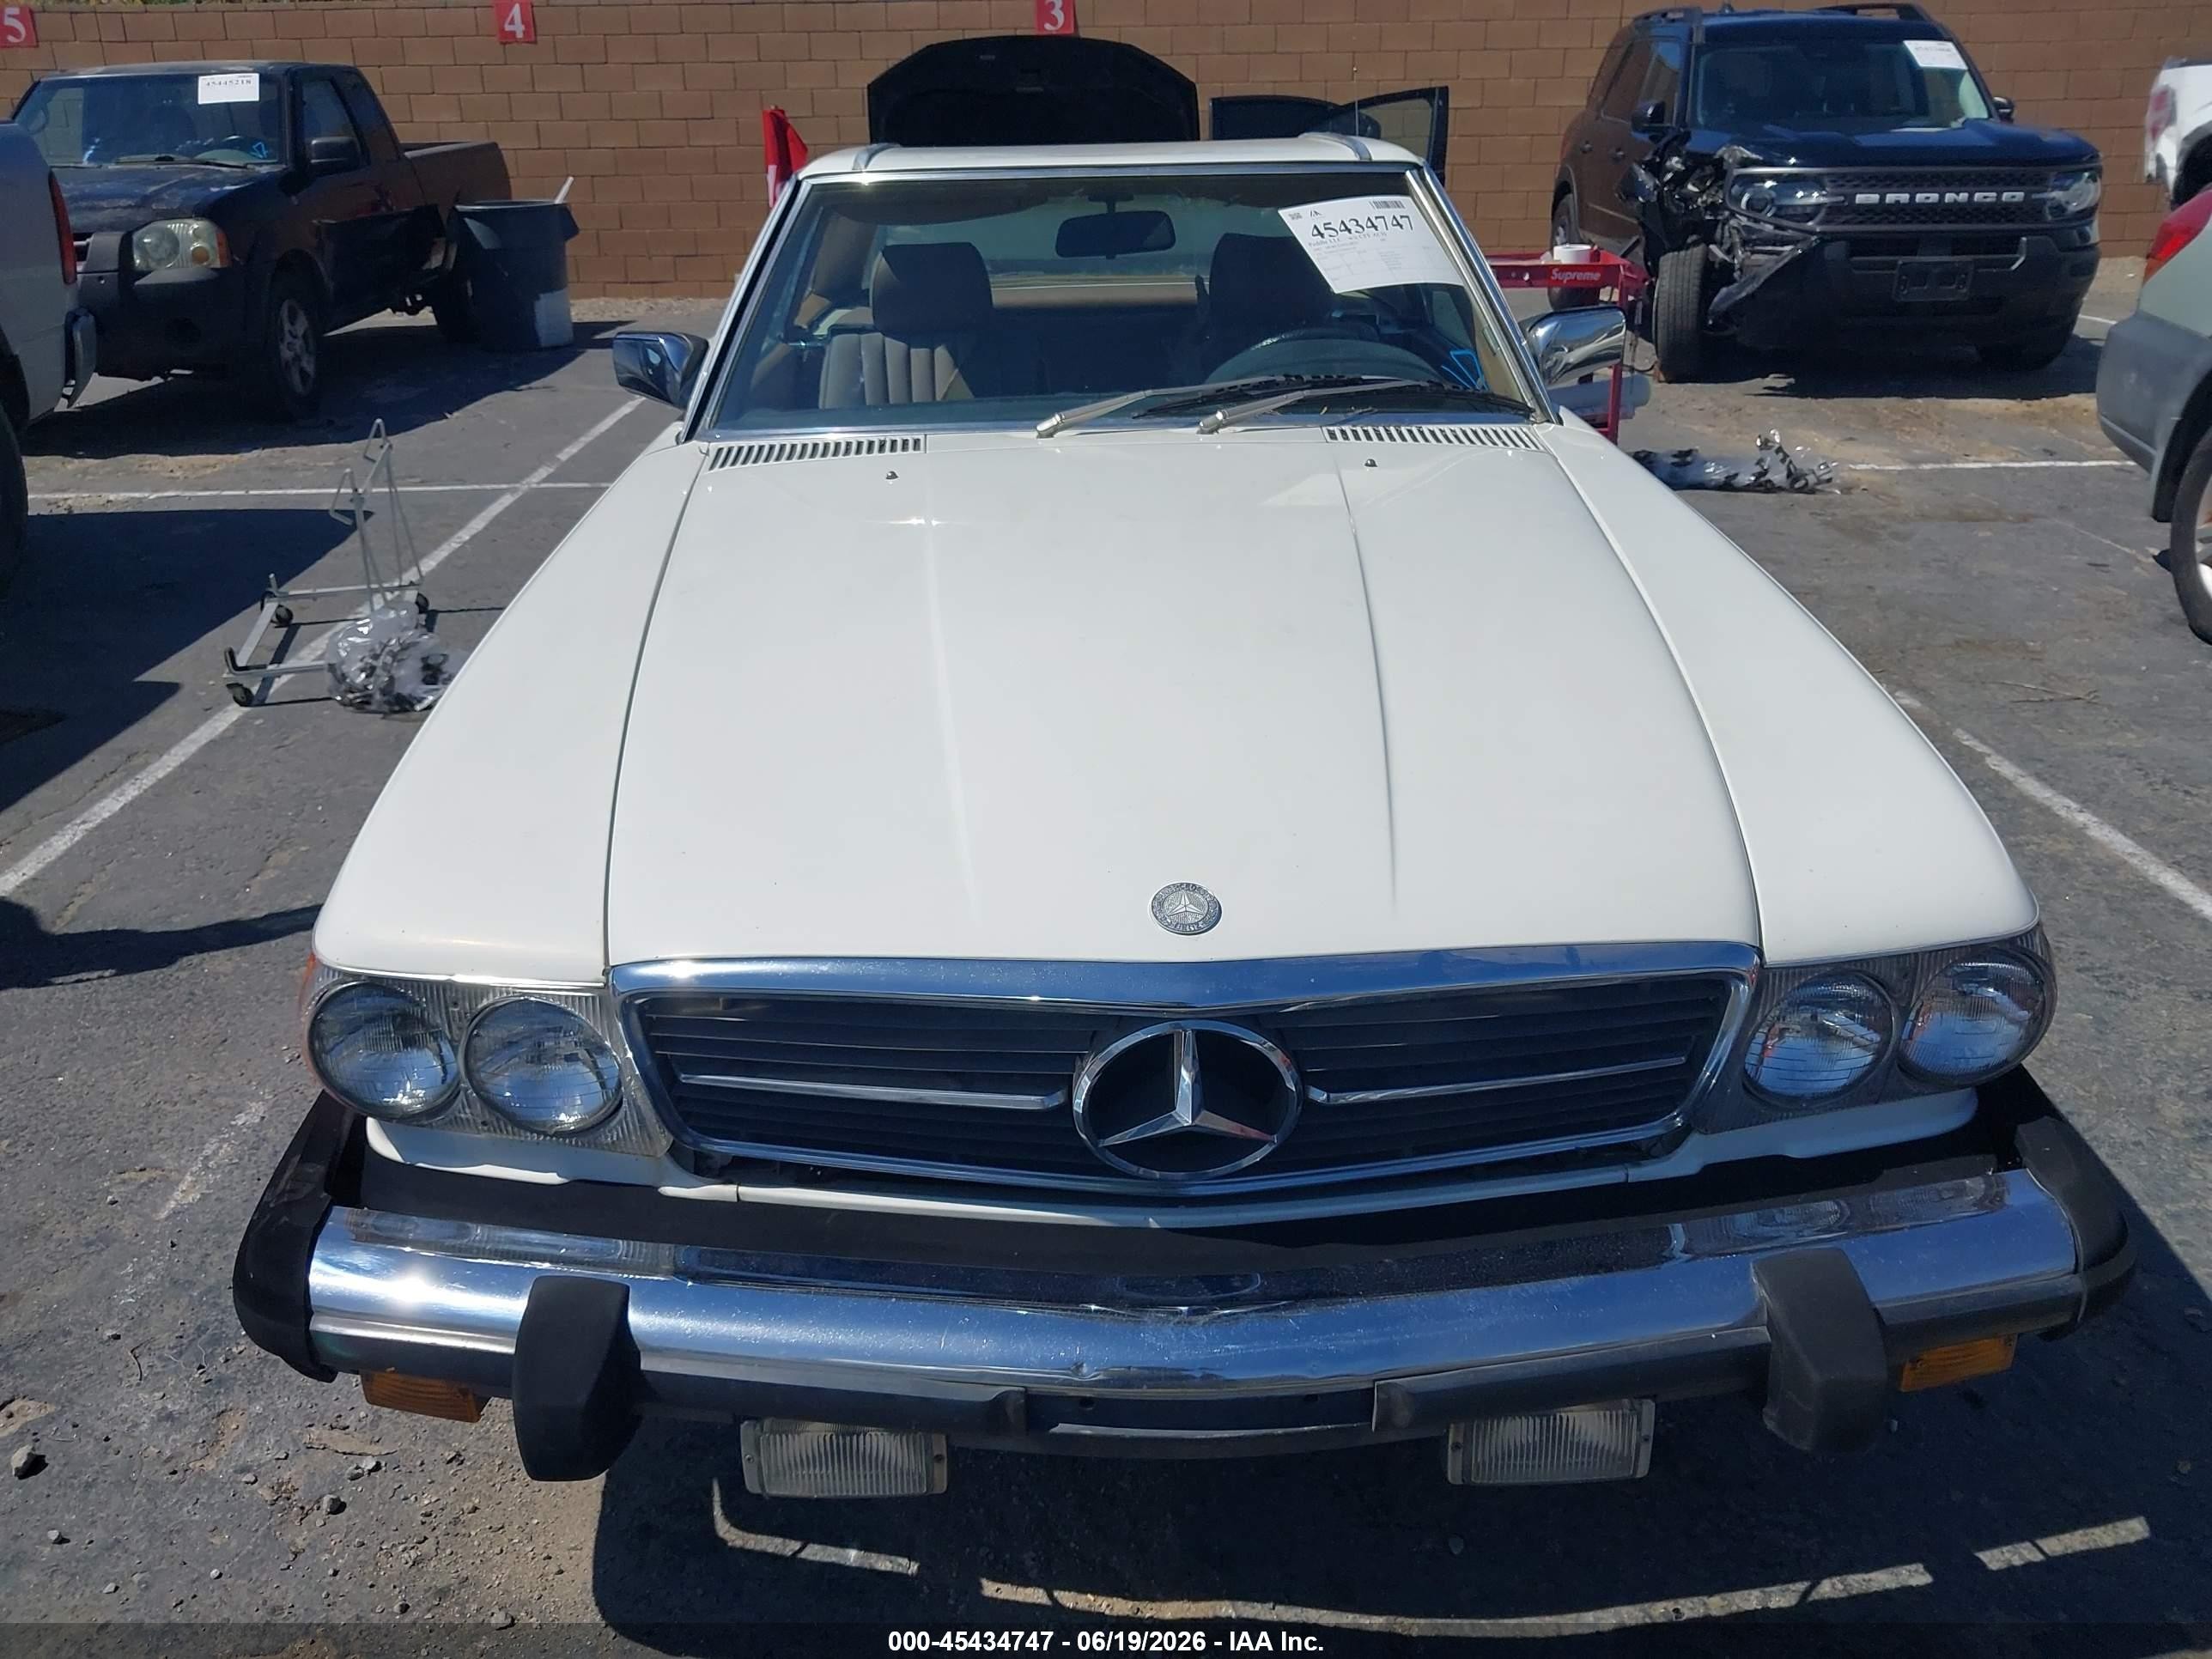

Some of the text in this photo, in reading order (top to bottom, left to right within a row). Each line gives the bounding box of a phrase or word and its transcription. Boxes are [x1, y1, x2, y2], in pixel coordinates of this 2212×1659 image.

[3, 7, 27, 43] 5
[504, 3, 526, 39] 4
[1043, 0, 1065, 31] 3
[1855, 191, 2025, 204] BRONCO
[1311, 215, 1413, 240] 45434747
[1551, 268, 1601, 284] Supreme
